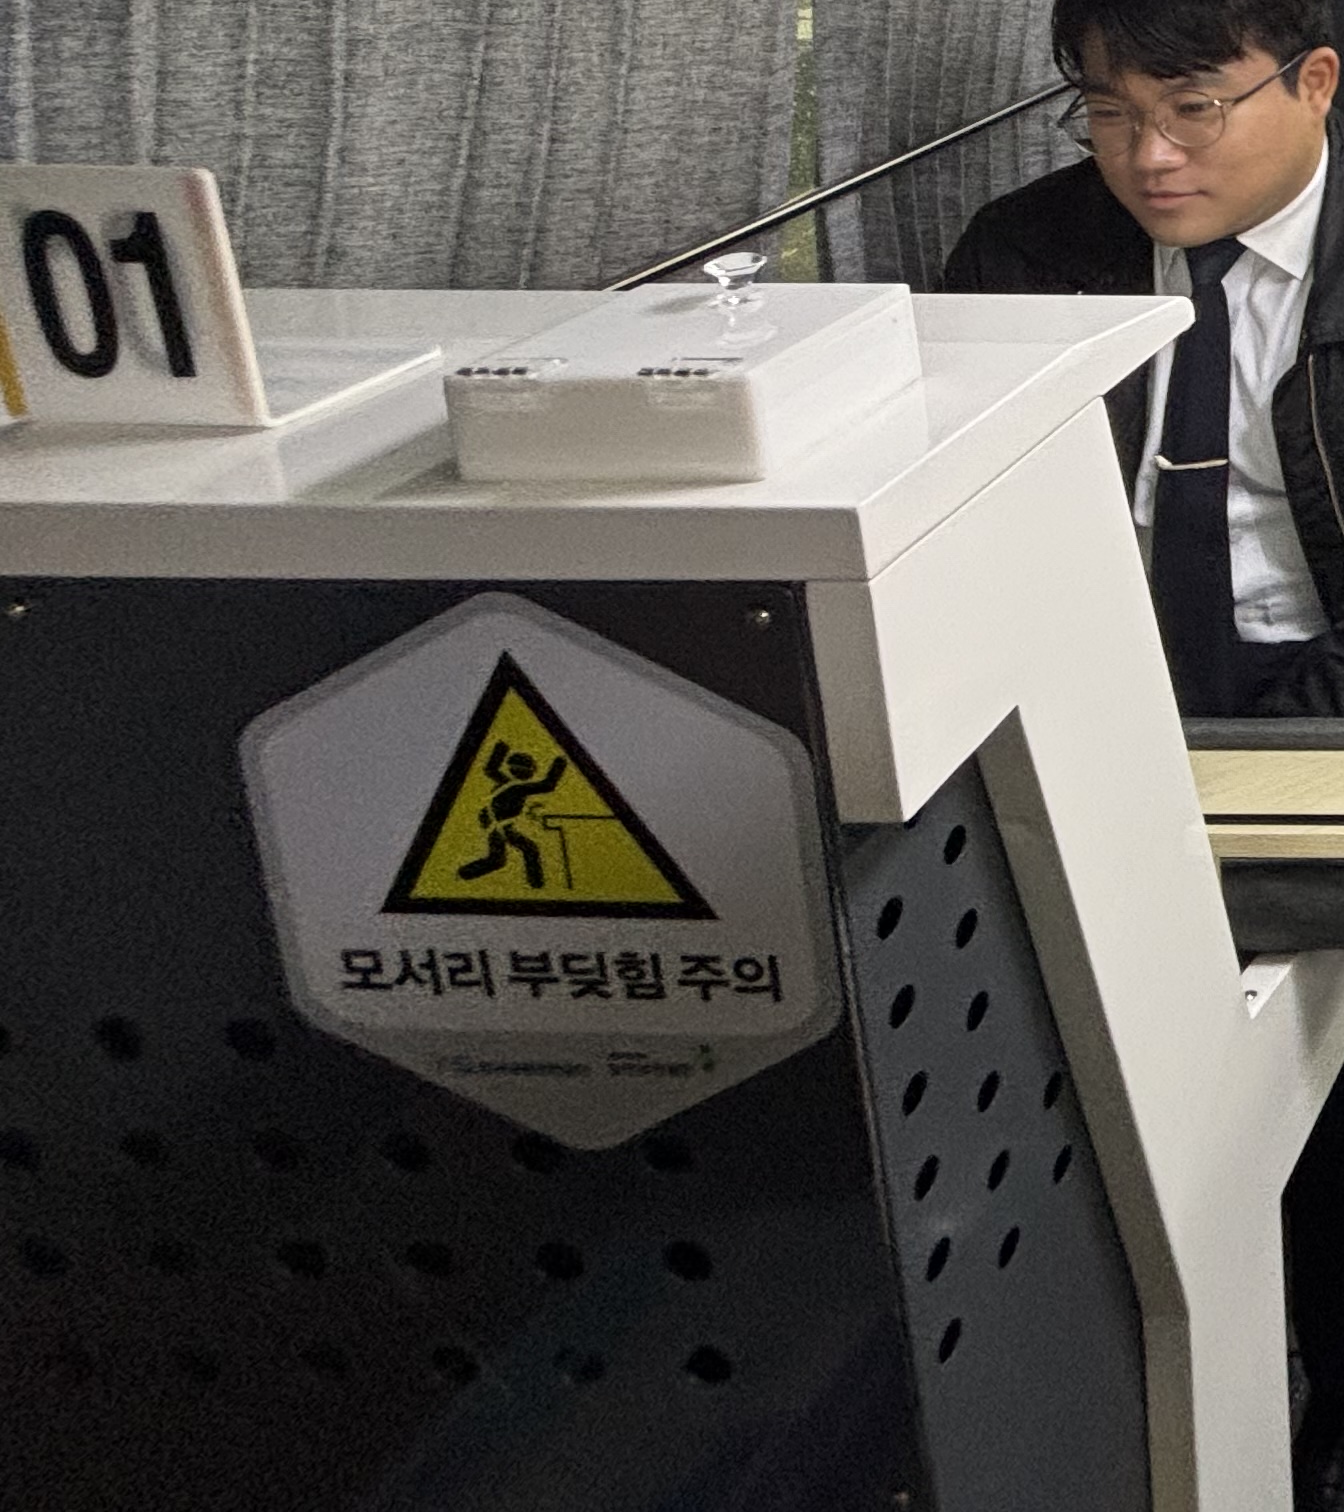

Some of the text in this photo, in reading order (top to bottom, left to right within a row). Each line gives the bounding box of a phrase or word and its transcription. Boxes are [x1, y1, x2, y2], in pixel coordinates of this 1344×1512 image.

[23, 210, 196, 378] 01
[341, 949, 783, 1004] 모서리 부딪힘 주의
